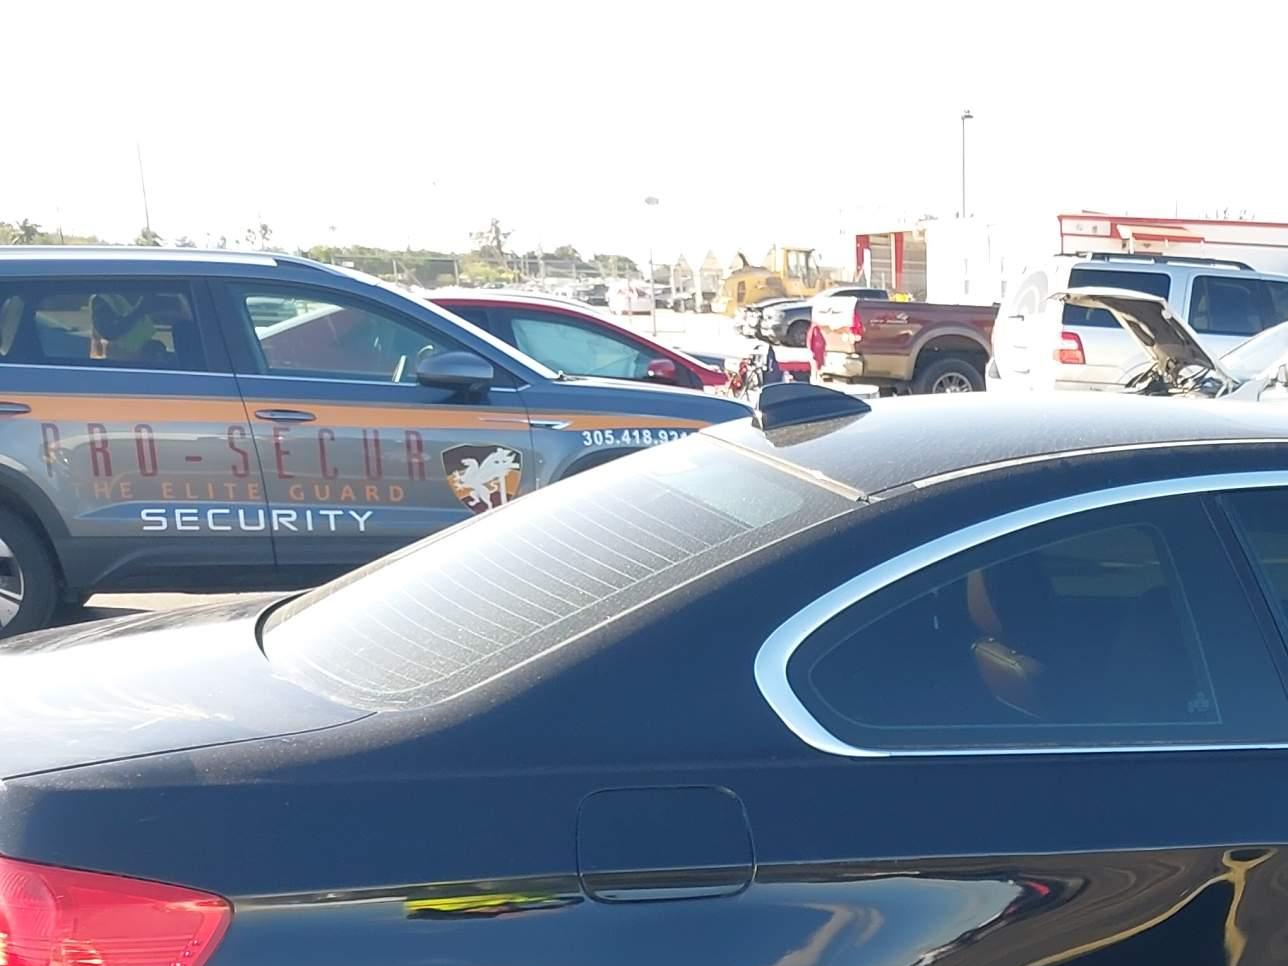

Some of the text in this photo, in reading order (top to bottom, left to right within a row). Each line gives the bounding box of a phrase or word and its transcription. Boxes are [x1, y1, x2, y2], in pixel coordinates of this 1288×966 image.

[582, 429, 693, 447] 305.418.92
[72, 481, 405, 501] THE ELITE GUARD
[140, 508, 373, 532] SECURITY
